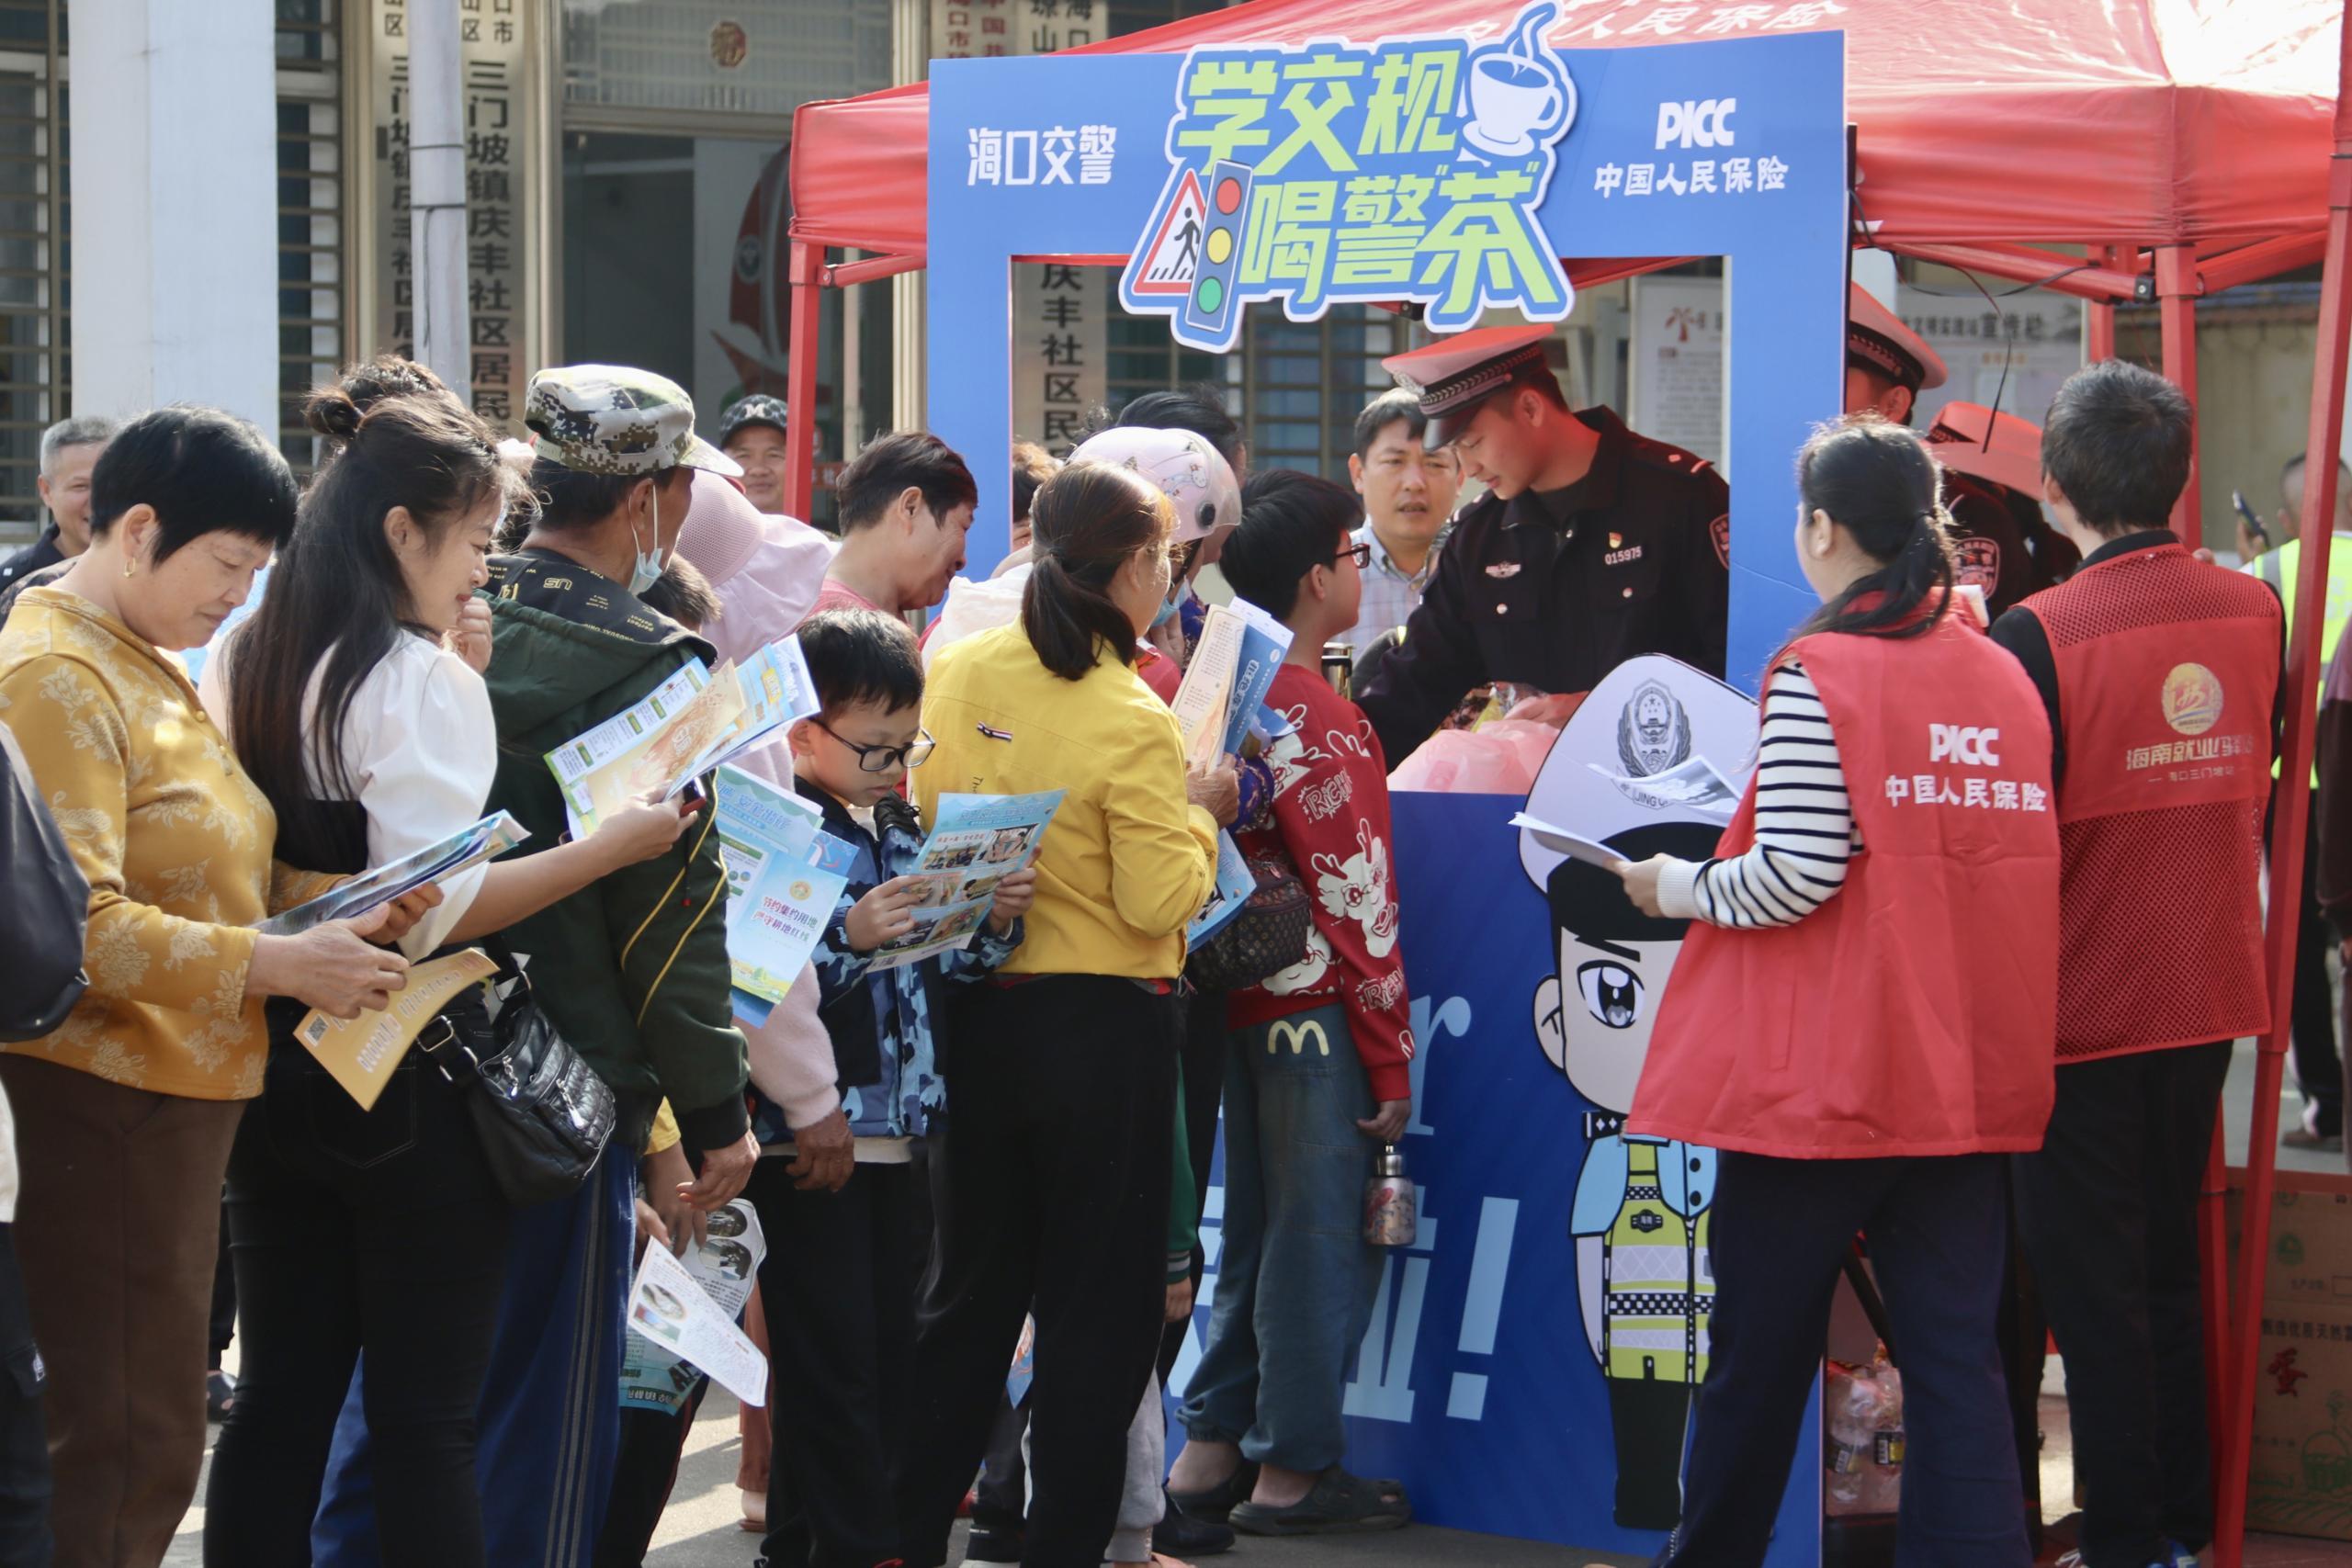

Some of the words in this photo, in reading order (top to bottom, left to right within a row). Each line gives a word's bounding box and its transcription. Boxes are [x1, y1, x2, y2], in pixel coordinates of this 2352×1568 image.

[1178, 50, 1461, 176] 学交规
[1655, 97, 1736, 150] PICC
[967, 125, 1117, 186] 海口交警
[1594, 155, 1789, 198] 中国人民保险
[1604, 546, 1643, 566] 015975
[1928, 723, 2000, 766] PICC
[1884, 774, 2047, 812] 中国人民保险
